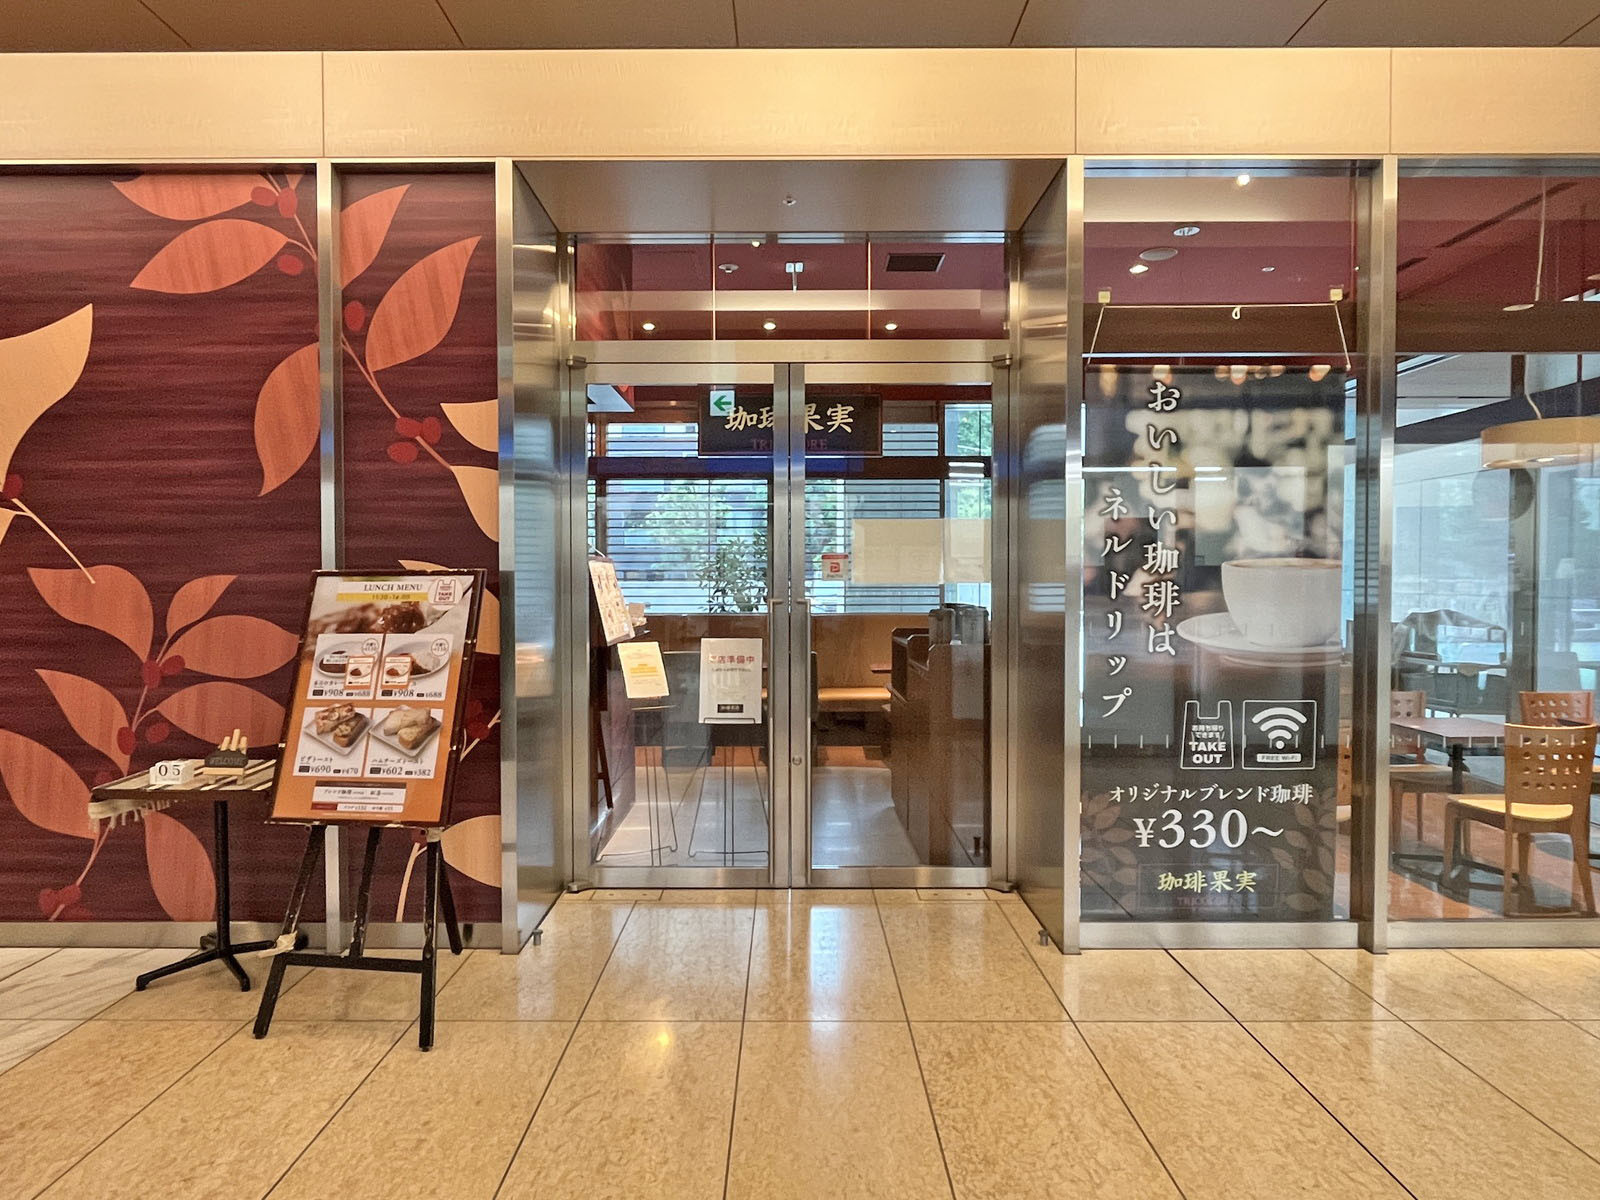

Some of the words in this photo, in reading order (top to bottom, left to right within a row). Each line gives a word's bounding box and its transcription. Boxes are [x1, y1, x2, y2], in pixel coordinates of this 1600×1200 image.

[1142, 381, 1181, 656] おいしい珈琲は
[364, 584, 394, 592] LUNCH
[396, 583, 423, 591] MENU
[1101, 488, 1133, 718] ネルドリップ
[1189, 741, 1227, 752] TAKE
[1192, 754, 1223, 764] OUT
[310, 765, 332, 774] ¥690
[382, 767, 403, 776] ¥602
[1108, 783, 1313, 804] オリジナルブレンド珈琲
[1157, 870, 1257, 893] 珈琲果実
